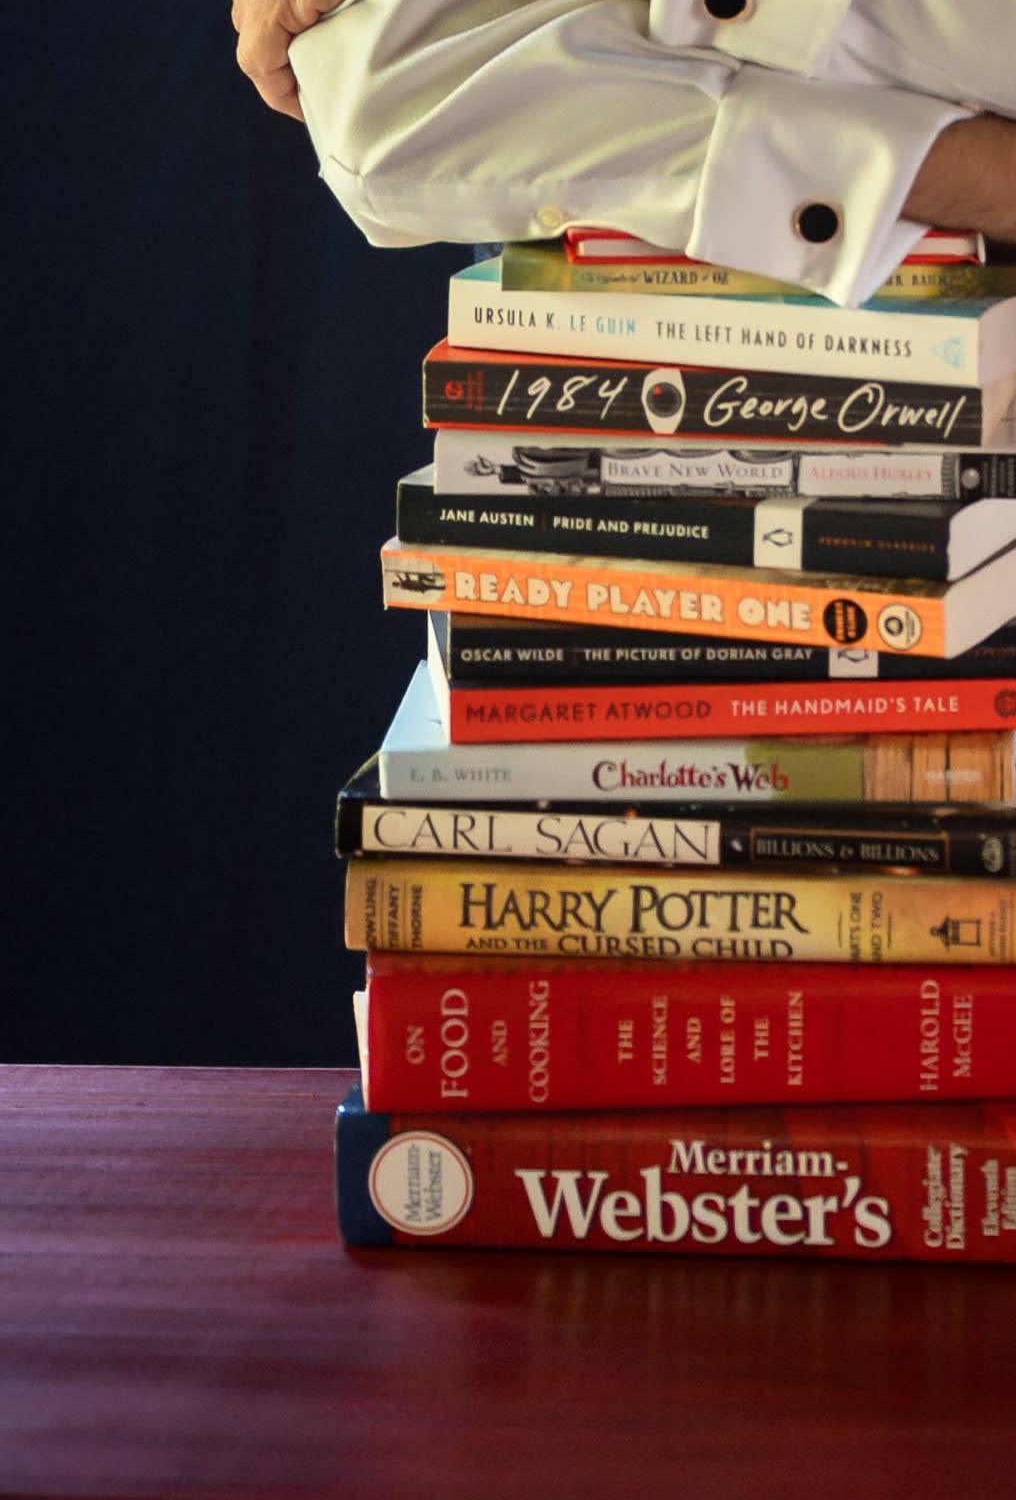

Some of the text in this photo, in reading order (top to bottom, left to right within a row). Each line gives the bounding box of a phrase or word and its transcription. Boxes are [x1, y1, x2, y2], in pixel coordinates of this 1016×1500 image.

[642, 270, 699, 285] WIZARD
[713, 272, 729, 285] OZ
[474, 307, 912, 357] URSULA K. LE GUIN THE LEFT HAND OF DARKNESS
[497, 369, 628, 420] 1984
[703, 376, 829, 431] George
[837, 382, 966, 438] Orwell
[607, 462, 932, 481] BRAVE NEW WORLD ALDOUS HUXLEY
[440, 509, 708, 539] JANE AUSTEN PRIDE AND PREJUDICE
[454, 571, 574, 609] READY
[586, 583, 724, 624] PLAYER
[737, 597, 811, 631] ONE
[461, 647, 813, 662] OSCAR WILDE THE PICTURE OF DORIAN GRAY
[466, 696, 959, 723] MARGARET ATWOOD THE HANDMAID'S TALE
[410, 758, 789, 793] E. B. WHITE Charlotte's Web
[374, 810, 512, 853] CARL
[536, 815, 710, 861] SAGAN
[756, 837, 834, 859] BILLIONS
[860, 842, 939, 863] BILLIONS
[388, 884, 400, 949] TIFFANY
[411, 884, 423, 949] THORNE
[458, 883, 809, 934] HARRY POTTER
[850, 891, 862, 921] ONE
[466, 934, 794, 959] AND THE CURSED CHILD
[407, 1026, 425, 1065] ON
[440, 988, 469, 1097] FOOD
[492, 1020, 508, 1066] AND
[529, 980, 549, 1103] COOKING
[619, 1019, 634, 1064] THE
[653, 995, 668, 1085] SCIENCE
[687, 1017, 701, 1064] AND
[720, 995, 736, 1084] LORE OF
[754, 1018, 770, 1061] THE
[788, 991, 804, 1086] KITCHEN
[920, 980, 940, 1091] HAROLD
[952, 994, 973, 1078] McGEE
[668, 1140, 849, 1178] Merriam-
[425, 1150, 442, 1222] Webster
[514, 1164, 892, 1248] Webster's
[923, 1144, 946, 1248] Collegiate
[947, 1142, 968, 1250] Dictionary
[981, 1159, 999, 1236] Eleventh
